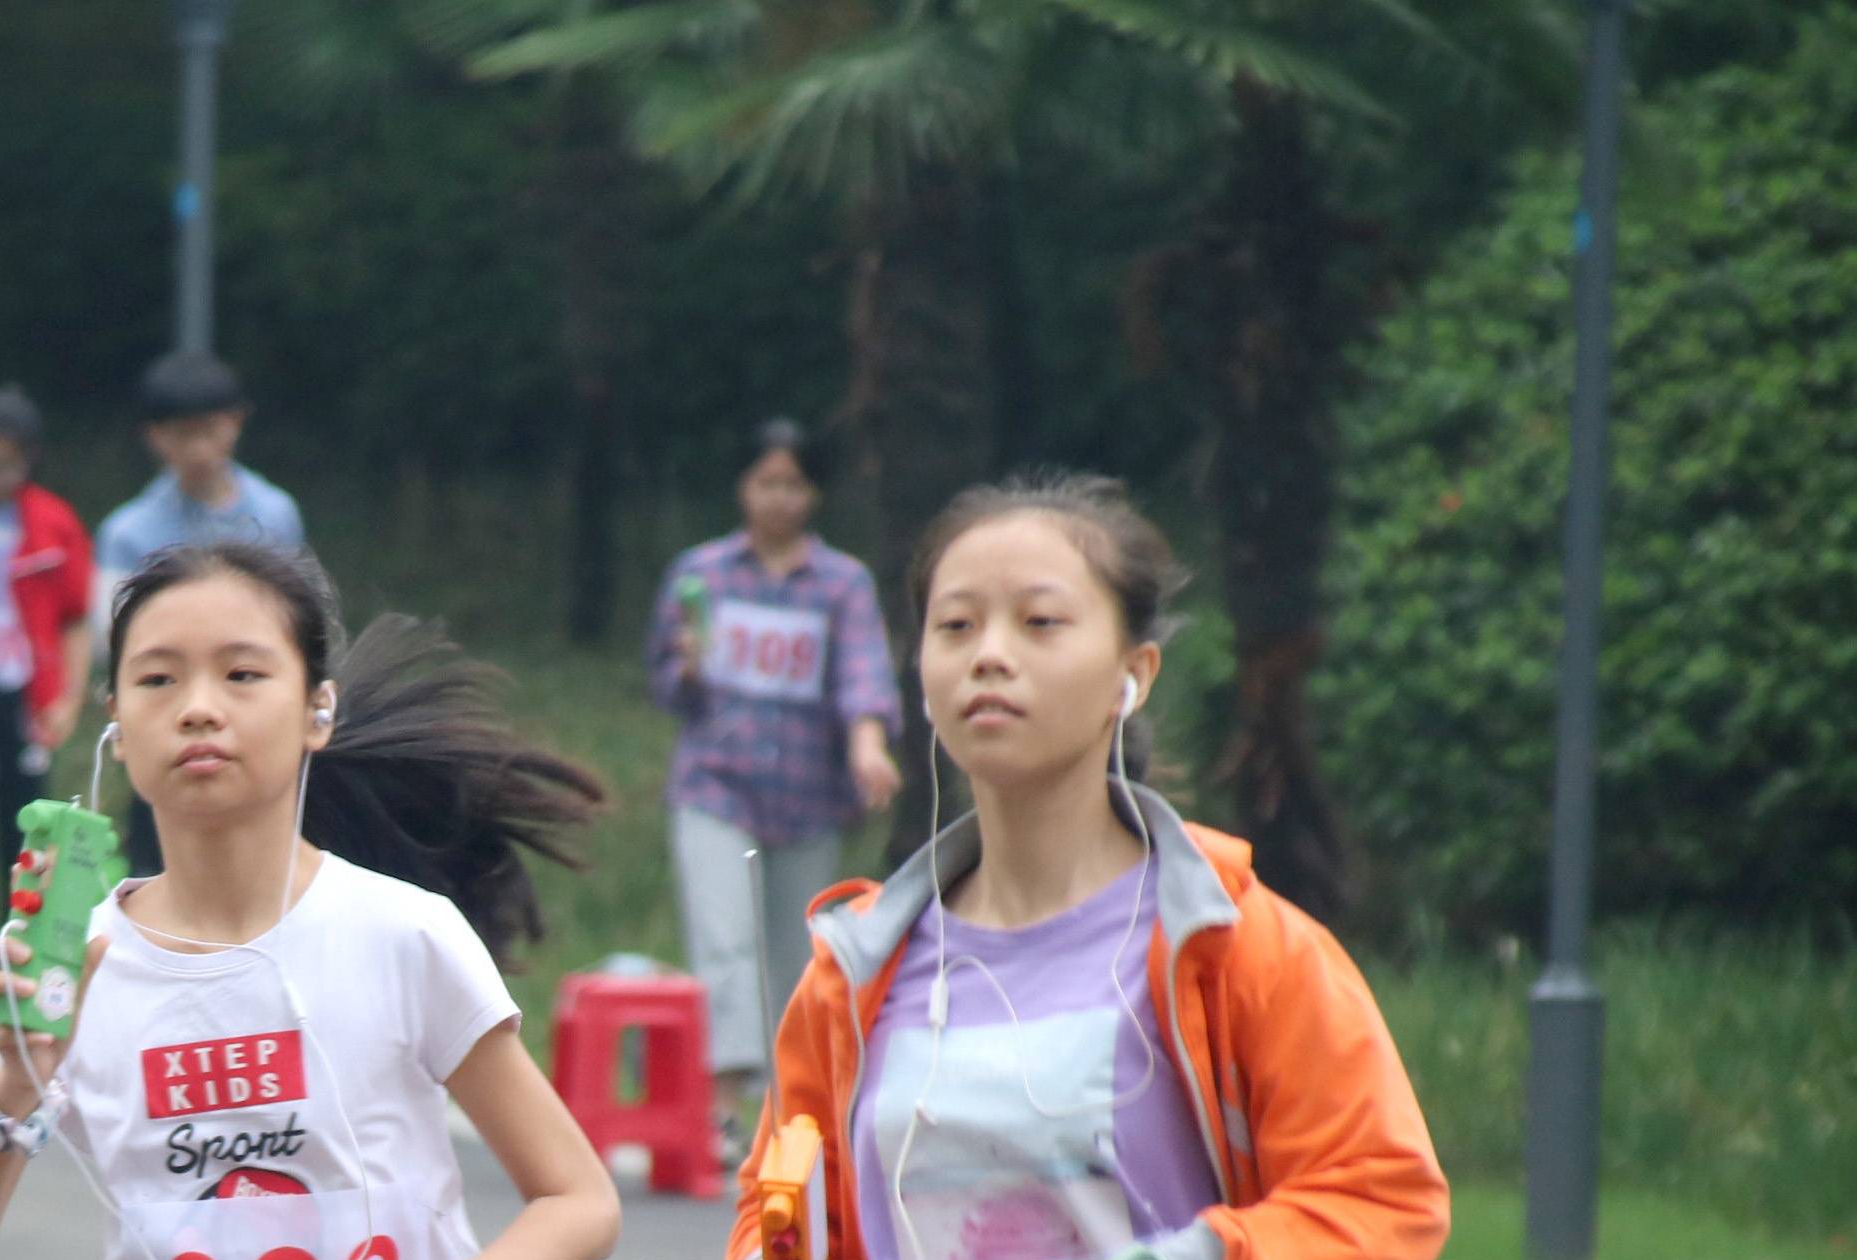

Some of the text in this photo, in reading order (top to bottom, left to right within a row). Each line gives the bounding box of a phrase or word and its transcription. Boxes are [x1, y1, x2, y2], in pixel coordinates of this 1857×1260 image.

[163, 1039, 279, 1078] XTEP
[168, 1072, 283, 1111] KIDS
[166, 1112, 307, 1178] Sport
